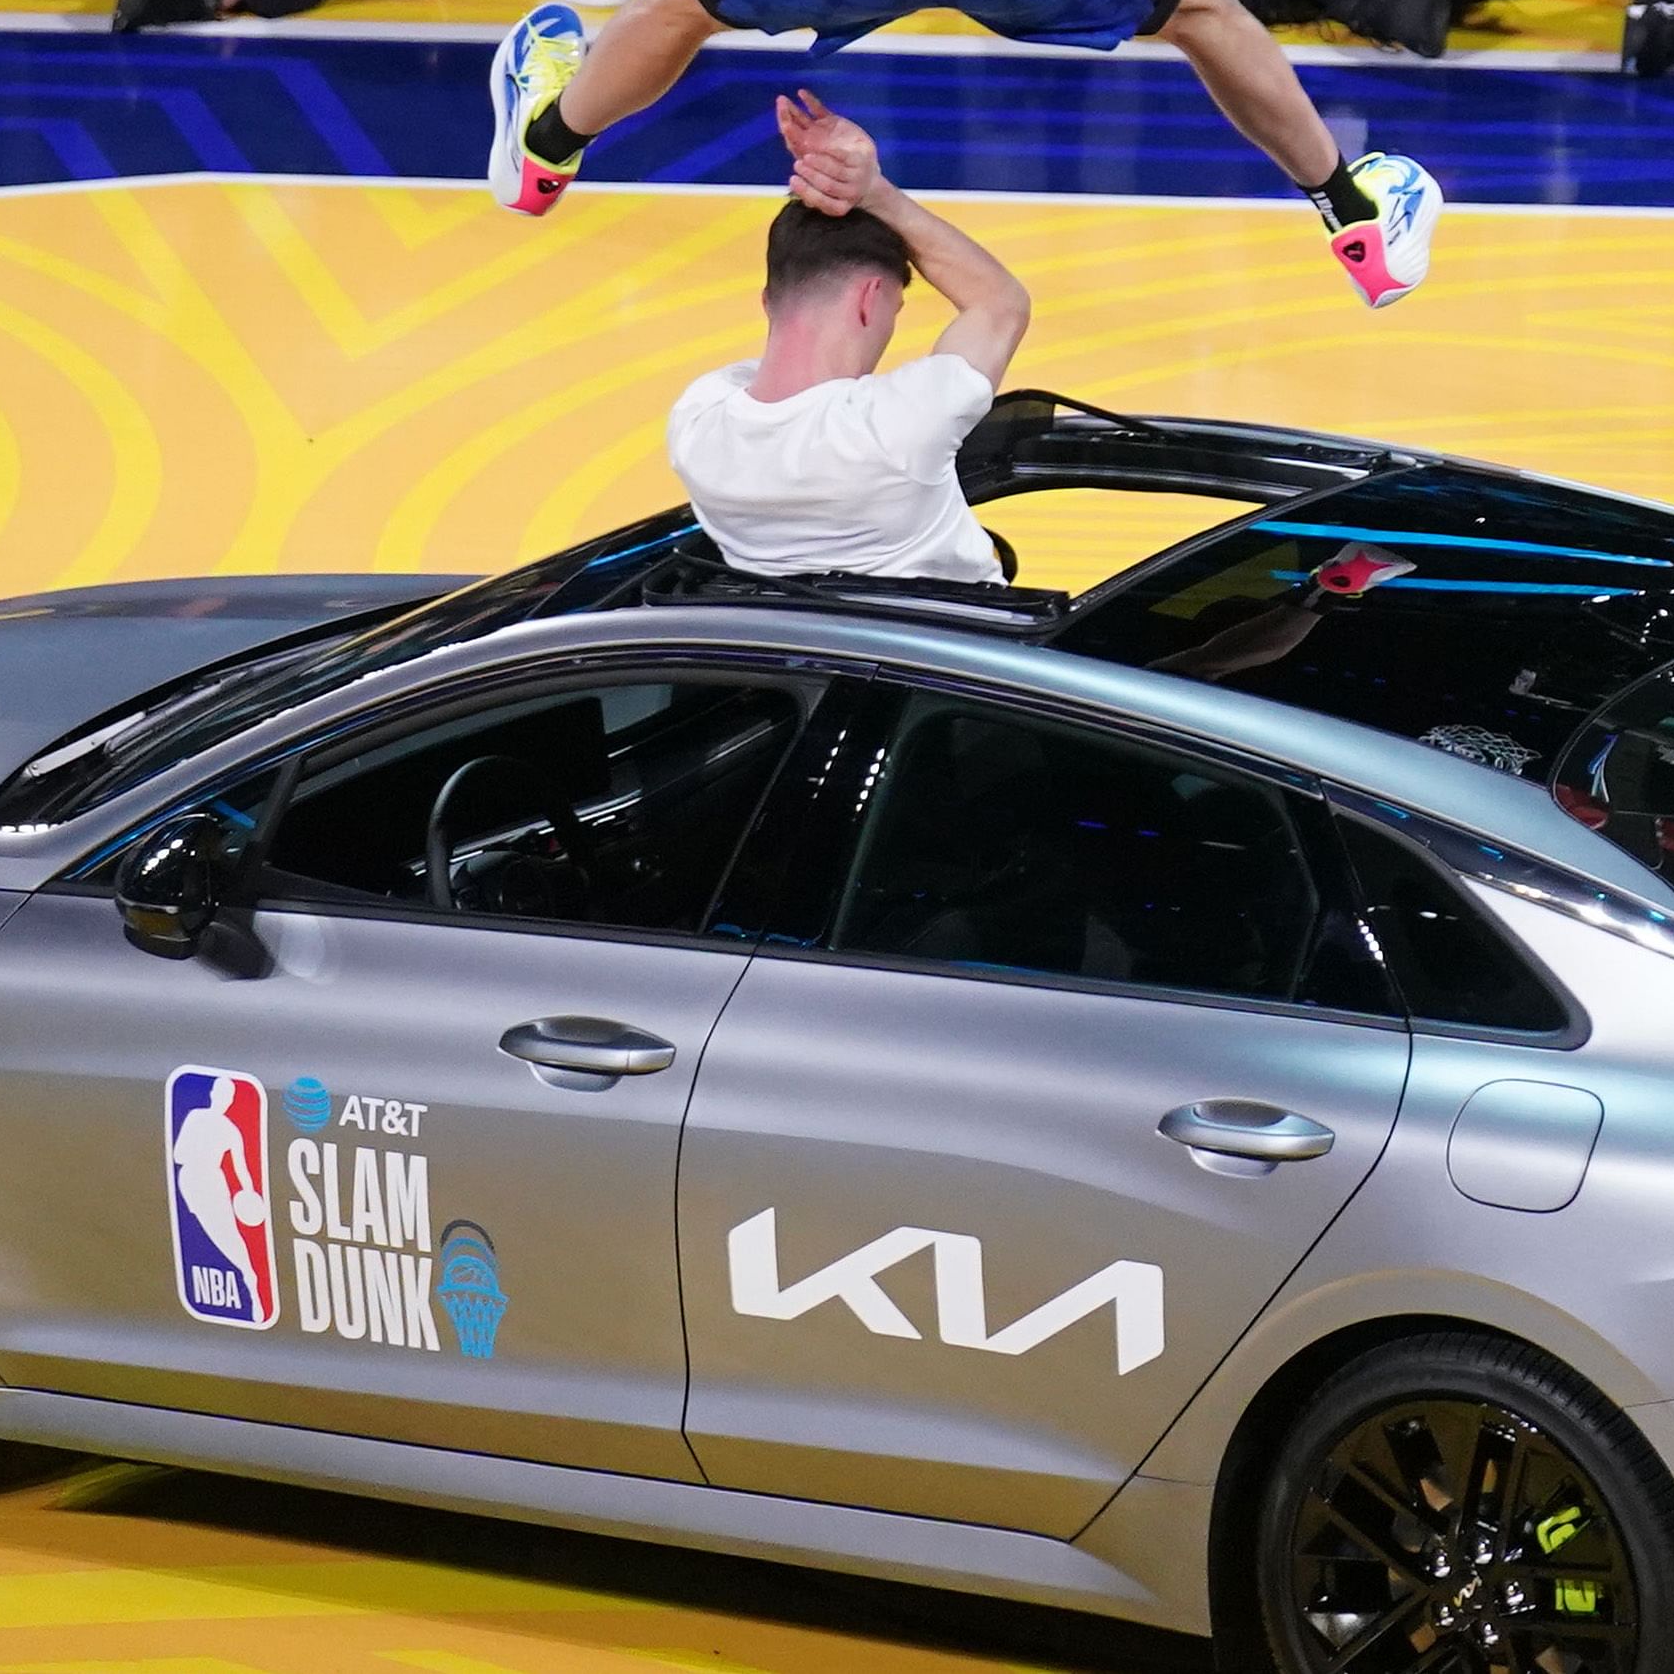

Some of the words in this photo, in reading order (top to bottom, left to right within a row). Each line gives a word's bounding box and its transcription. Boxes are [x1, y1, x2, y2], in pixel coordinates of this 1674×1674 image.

[338, 1094, 429, 1138] AT&T
[287, 1137, 433, 1253] SLAM
[191, 1264, 243, 1310] NBA
[292, 1237, 442, 1352] DUNK
